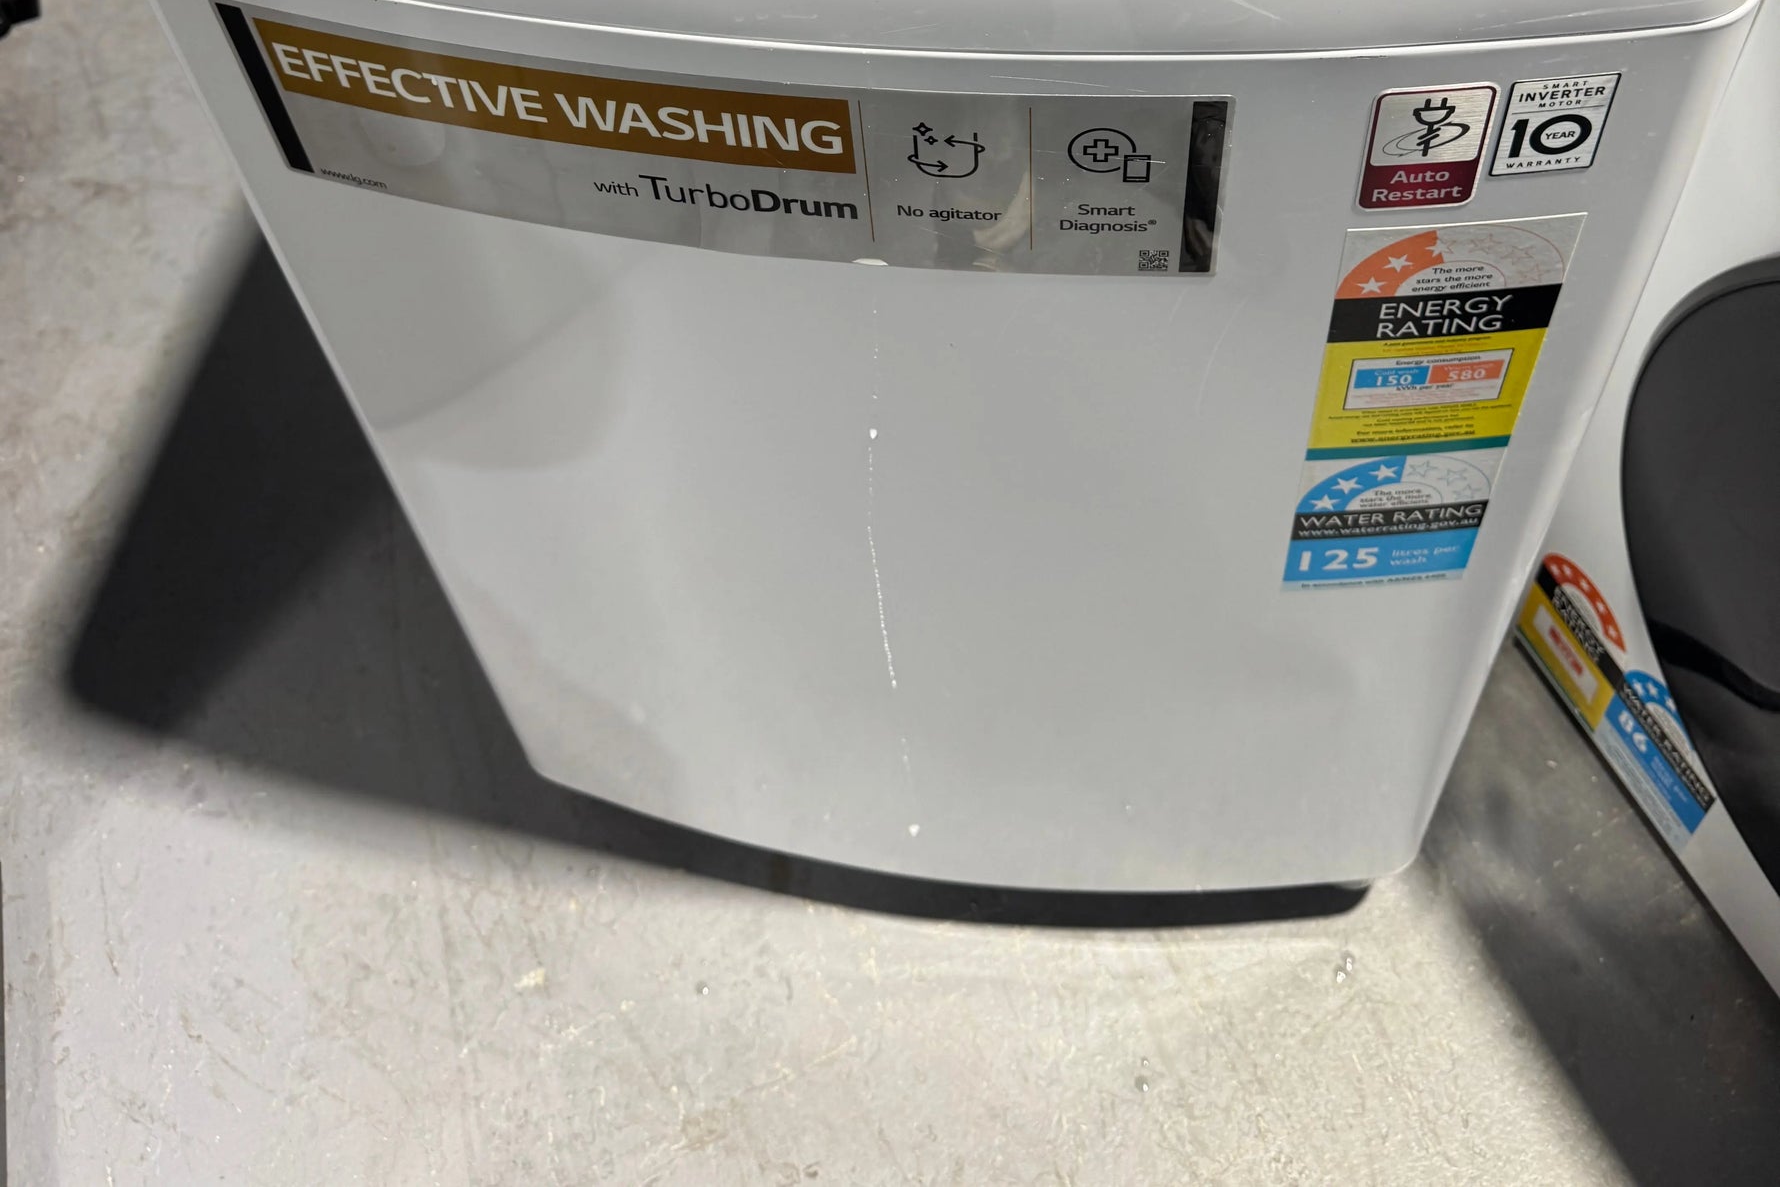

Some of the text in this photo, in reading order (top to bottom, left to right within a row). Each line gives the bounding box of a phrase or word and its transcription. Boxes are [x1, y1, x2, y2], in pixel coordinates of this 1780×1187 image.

[1542, 80, 1590, 90] SMART
[271, 41, 843, 155] EFFECTIVE WASHING
[1519, 86, 1606, 103] INVERTER
[1538, 99, 1582, 108] MOTOR
[1508, 113, 1593, 159] 10
[1544, 130, 1576, 140] YEAR
[1505, 156, 1582, 169] WARRANTY
[320, 168, 388, 189] www.lg.com
[1390, 170, 1450, 185] Auto
[593, 174, 858, 220] with TurboDrum
[1372, 185, 1463, 203] Restart
[897, 204, 1003, 222] No agitator
[1077, 203, 1136, 217] Smart
[1450, 282, 1491, 290] efficient
[1379, 294, 1513, 320] ENERGY
[1376, 315, 1504, 338] RATING
[1376, 374, 1413, 387] 150
[1447, 368, 1486, 381] 580
[1300, 504, 1483, 528] WATER RATING
[1298, 517, 1480, 537] www.waterrating.gov.au
[1299, 547, 1380, 572] 125
[1392, 544, 1461, 558] litres per
[1390, 556, 1428, 567] wash
